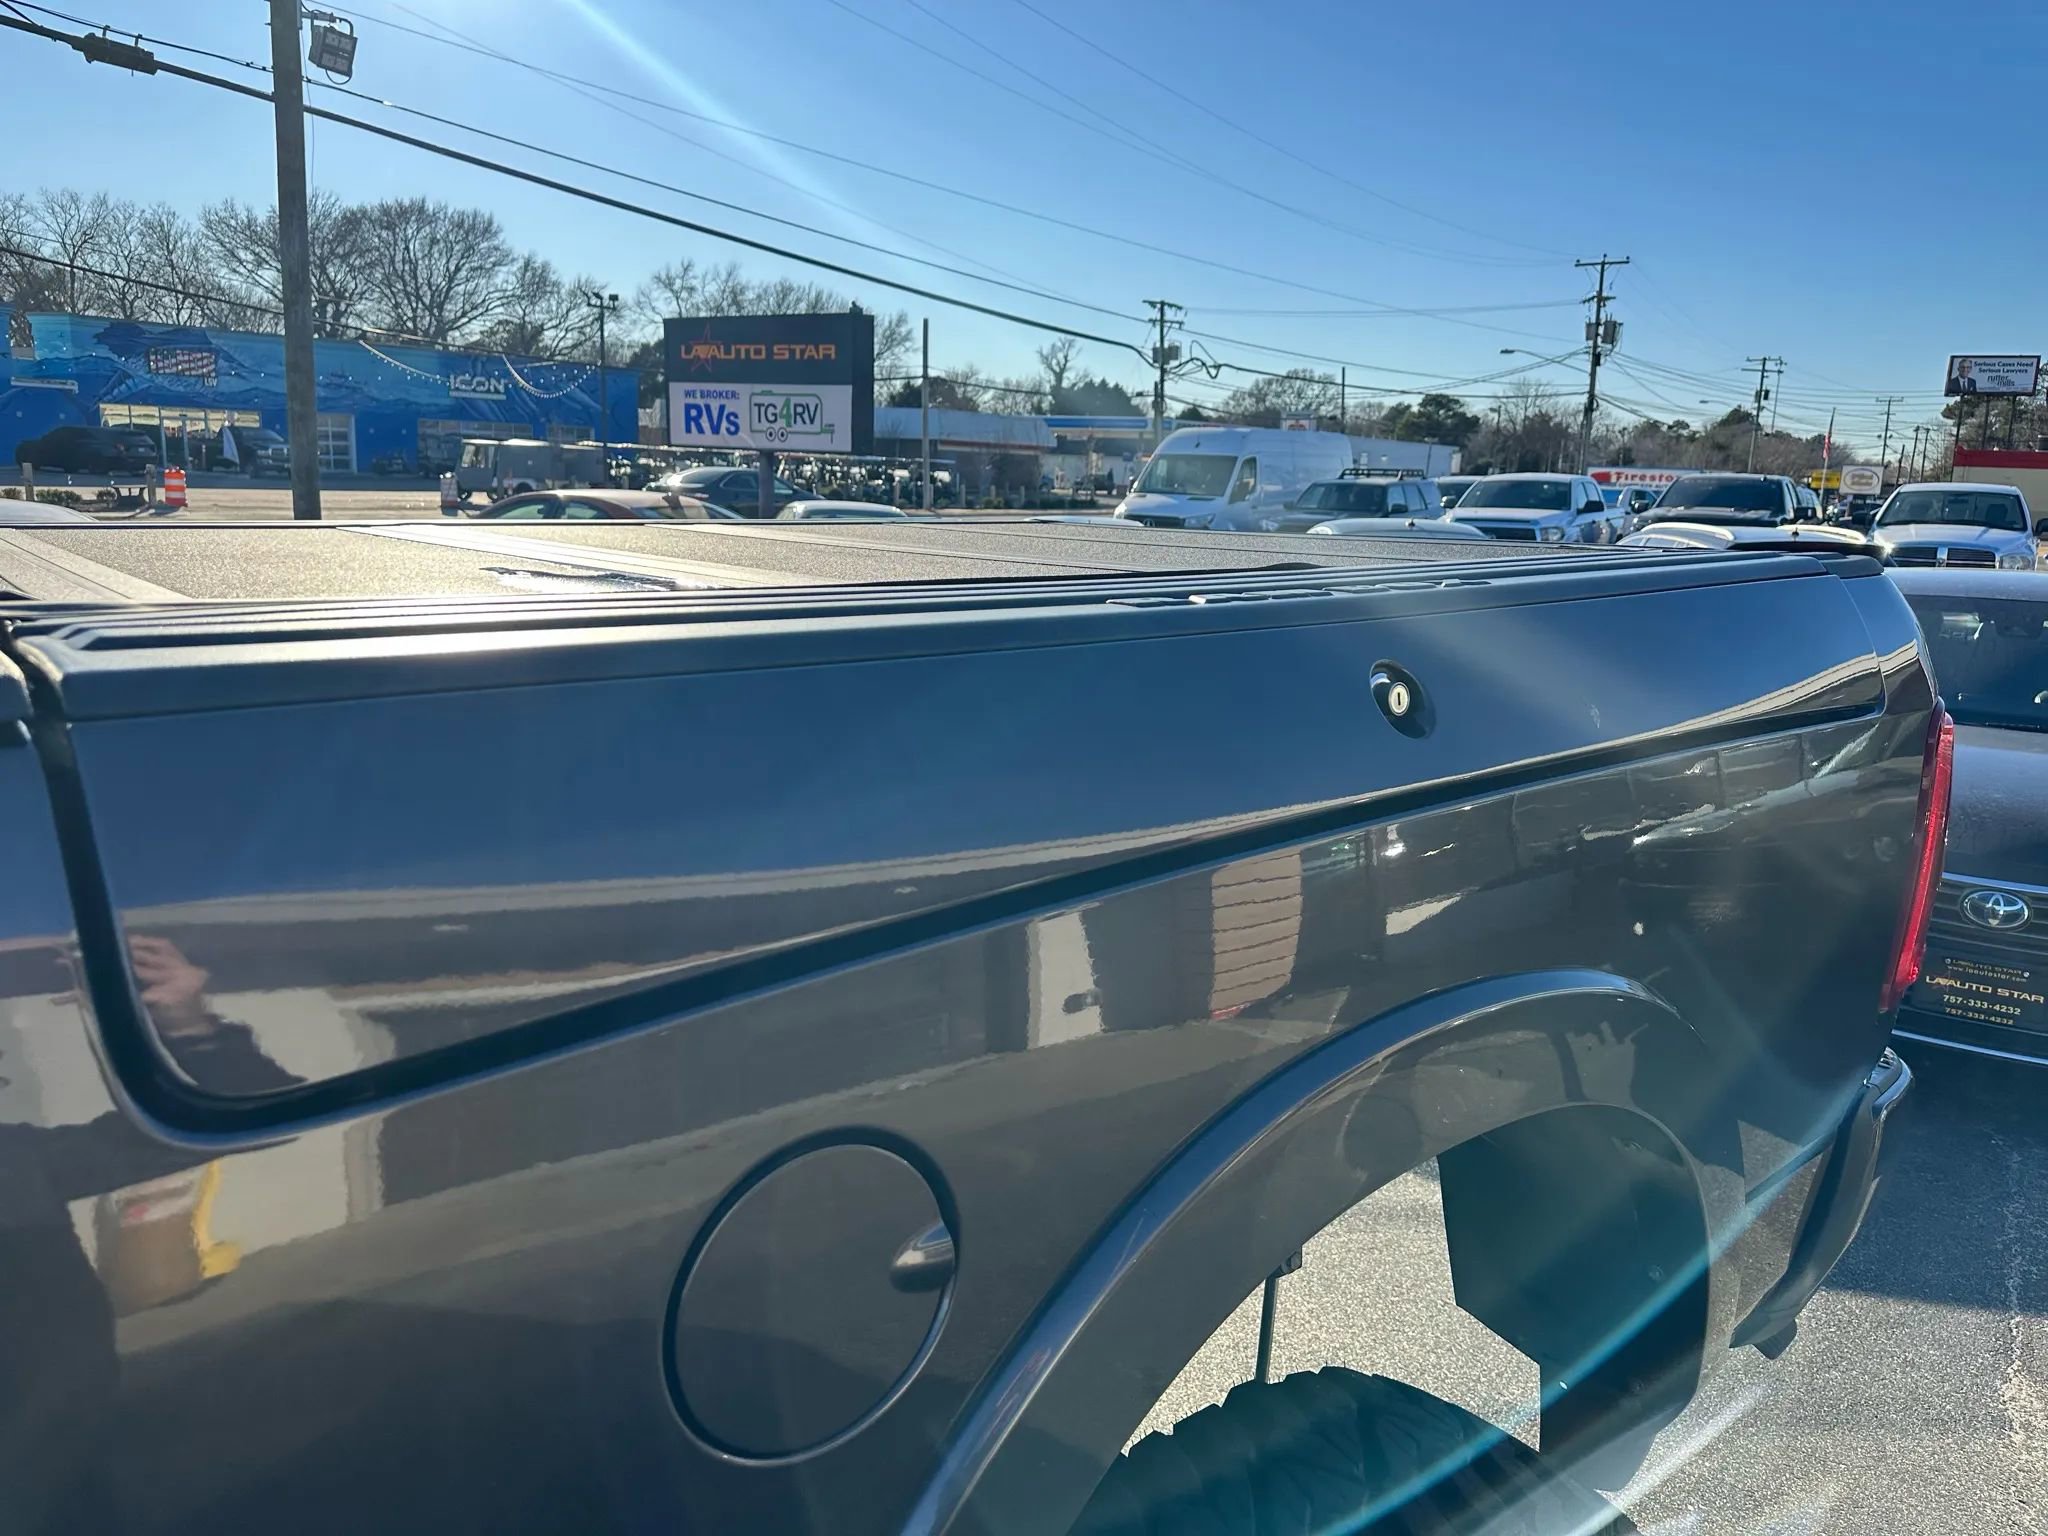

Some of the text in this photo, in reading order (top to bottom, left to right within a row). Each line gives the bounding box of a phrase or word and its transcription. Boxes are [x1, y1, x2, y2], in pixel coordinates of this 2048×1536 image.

[772, 344, 836, 360] STAR
[449, 374, 505, 393] ICON
[684, 389, 740, 400] WE BROKER:
[684, 403, 740, 436] RVs
[753, 398, 819, 428] TG4RV
[1615, 471, 1676, 483] Firesto
[1997, 988, 2045, 1004] STAR
